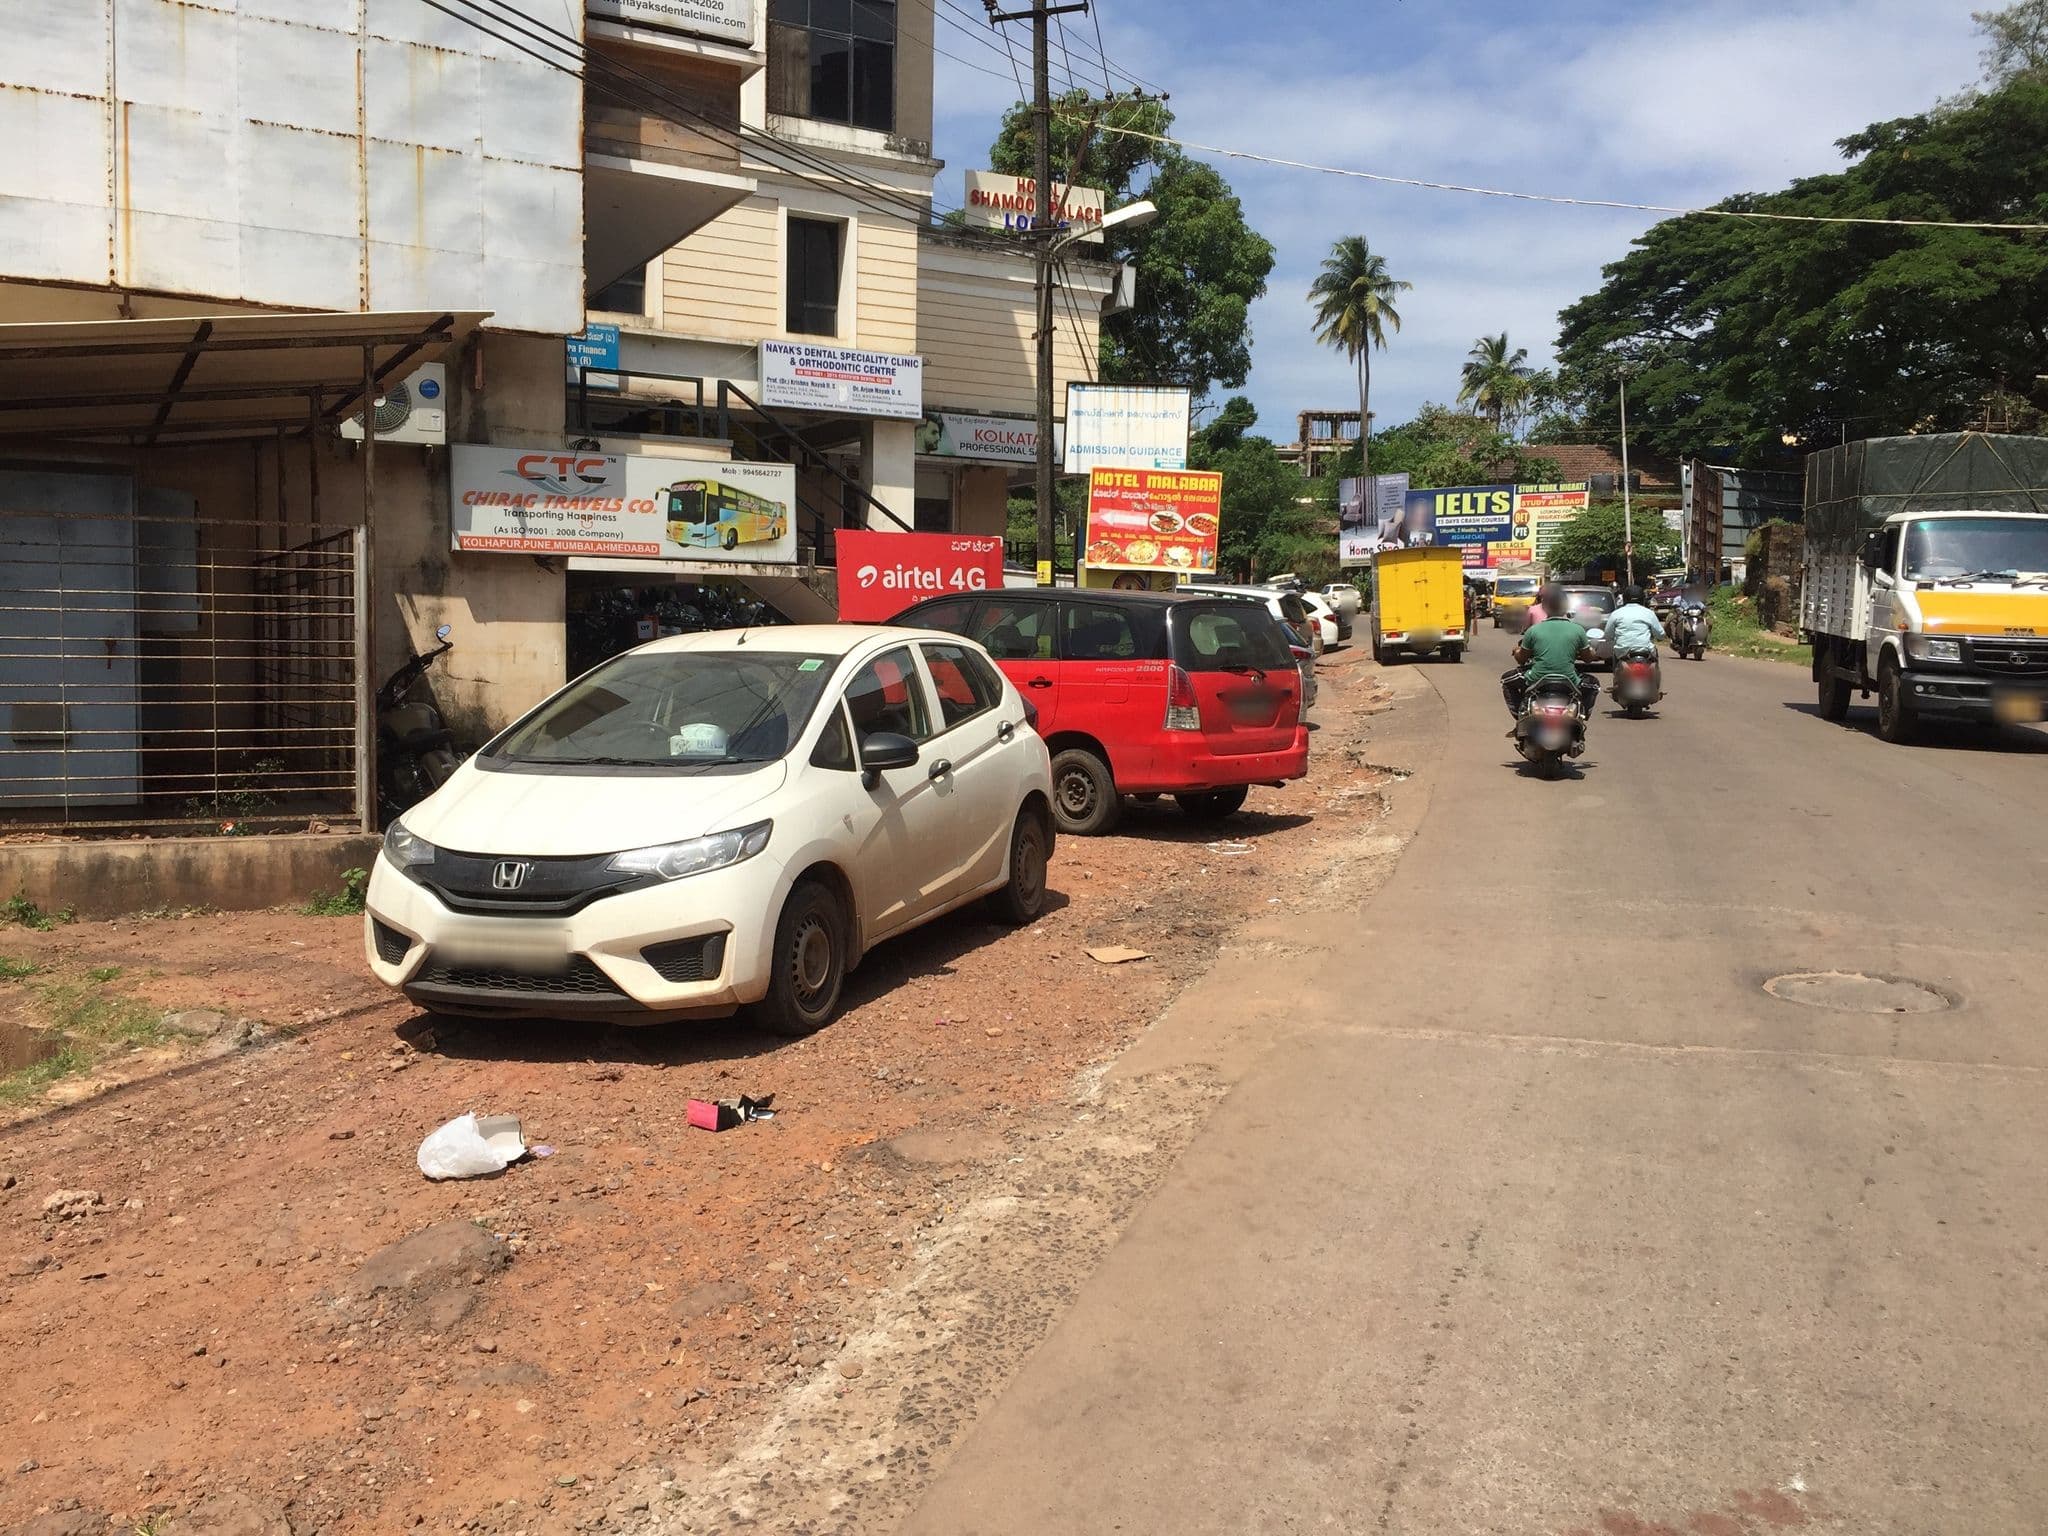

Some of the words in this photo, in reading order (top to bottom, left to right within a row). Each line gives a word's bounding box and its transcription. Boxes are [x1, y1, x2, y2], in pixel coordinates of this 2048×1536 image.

[578, 345, 607, 355] Finance
[765, 342, 803, 356] NAYAK'S
[804, 347, 838, 360] DENTAL
[840, 351, 889, 366] SPECIALITY
[891, 357, 919, 369] CLINIC
[789, 358, 797, 366] &
[798, 358, 862, 373] ORTHODONTIC
[863, 365, 897, 377] CENTRE
[959, 442, 1026, 456] PROFESSIONAL
[1069, 445, 1126, 455] ADMISSION
[1129, 446, 1183, 457] GUIDANCE
[516, 455, 608, 484] CTC
[721, 467, 737, 475] Mob
[1094, 472, 1140, 488] HOTEL
[1147, 475, 1219, 491] MALABAR
[462, 489, 540, 509] CHIRAG
[541, 494, 624, 513] TRAVELS
[627, 498, 658, 514] CO.
[1435, 491, 1511, 516] IELTS
[1548, 498, 1585, 506] ABROAD?
[503, 508, 564, 522] Transporting
[1481, 516, 1505, 524] COURSE
[493, 525, 509, 535] (As
[511, 526, 527, 536] ISO
[528, 526, 549, 537] 9001
[556, 528, 577, 538] 2008
[578, 529, 624, 540] Company)
[1514, 527, 1528, 537] PTE
[1349, 545, 1375, 556] Home
[882, 563, 944, 590] airtel
[949, 566, 986, 591] 4G
